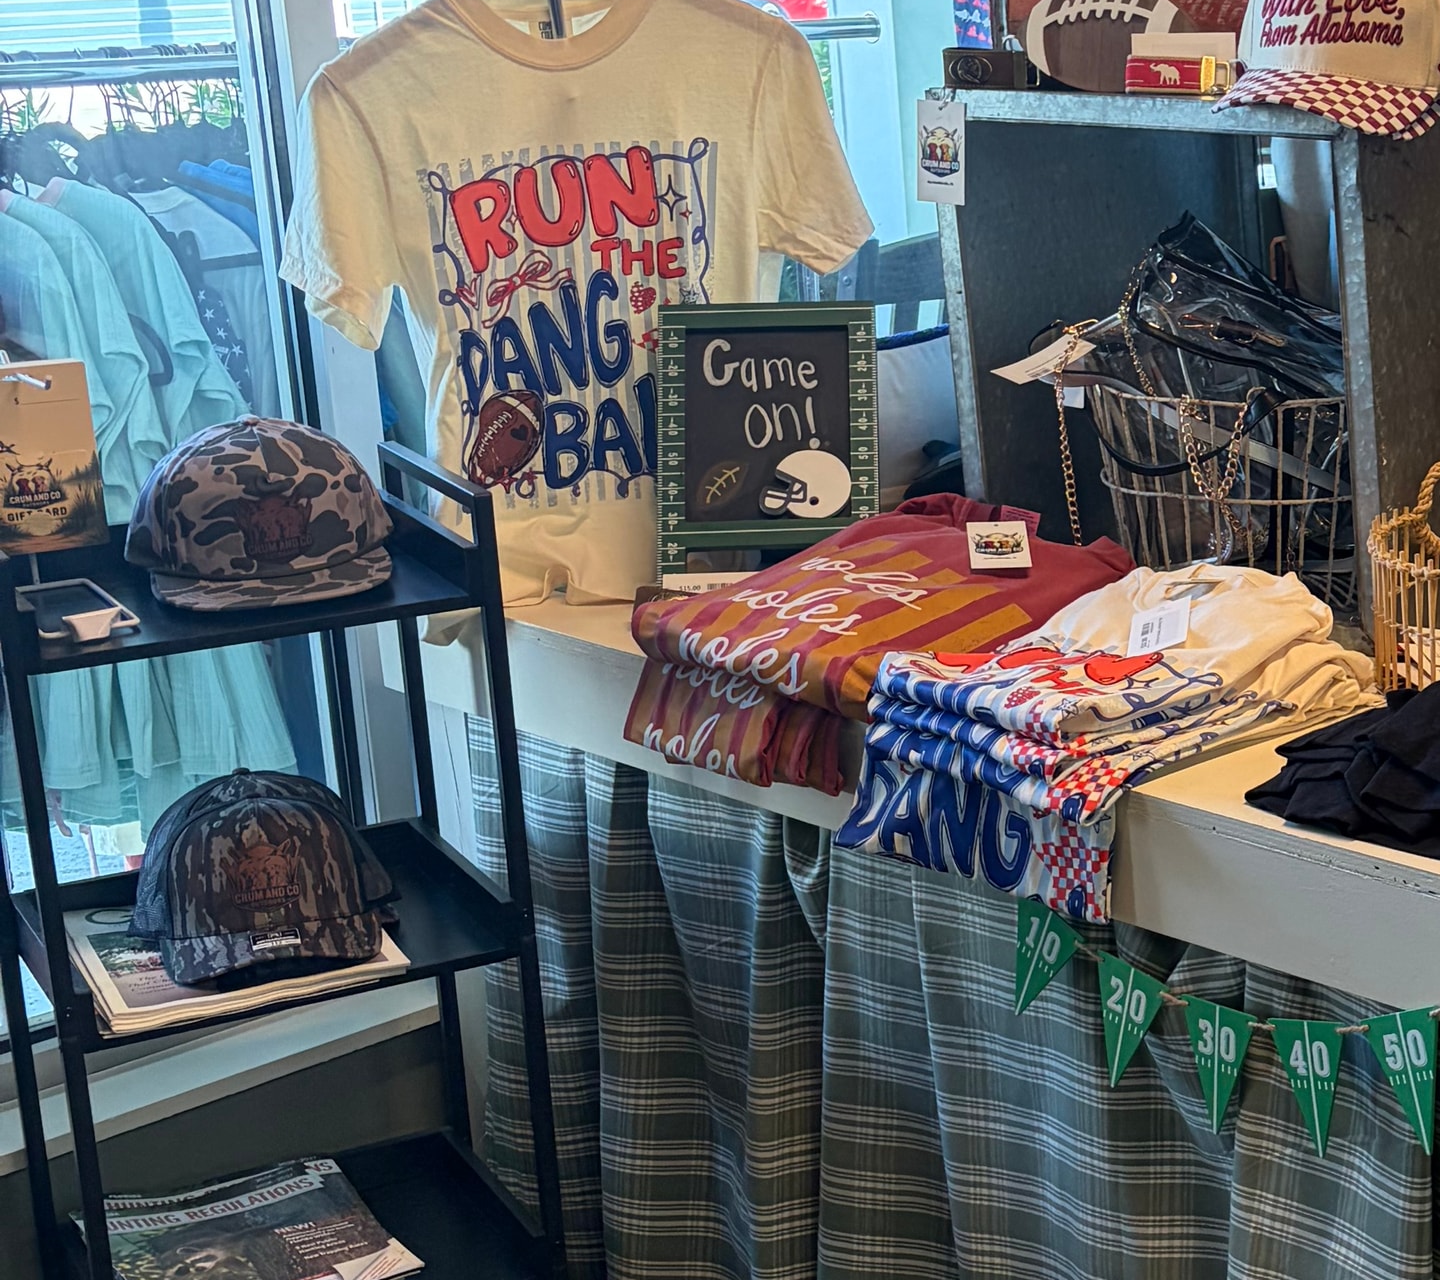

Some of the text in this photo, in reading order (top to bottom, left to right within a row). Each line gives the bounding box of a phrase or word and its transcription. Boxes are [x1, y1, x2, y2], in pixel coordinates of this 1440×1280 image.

[1260, 12, 1404, 49] From Alabama
[450, 145, 660, 274] RUN
[590, 236, 686, 279] THE
[459, 269, 634, 416] DANG
[703, 338, 818, 393] Game
[9, 490, 61, 505] CRUM AND CO
[797, 554, 928, 610] noles
[729, 586, 863, 637] noles
[679, 627, 808, 696] noles
[834, 760, 1034, 894] DANG
[235, 884, 299, 904] CRUM AND CO
[1024, 916, 1062, 965] 10
[1106, 975, 1147, 1024] 20
[1198, 1019, 1236, 1063] 30
[1290, 1039, 1331, 1079] 40
[1383, 1028, 1428, 1071] 50
[108, 1177, 315, 1232] UNTING REGULATIONS
